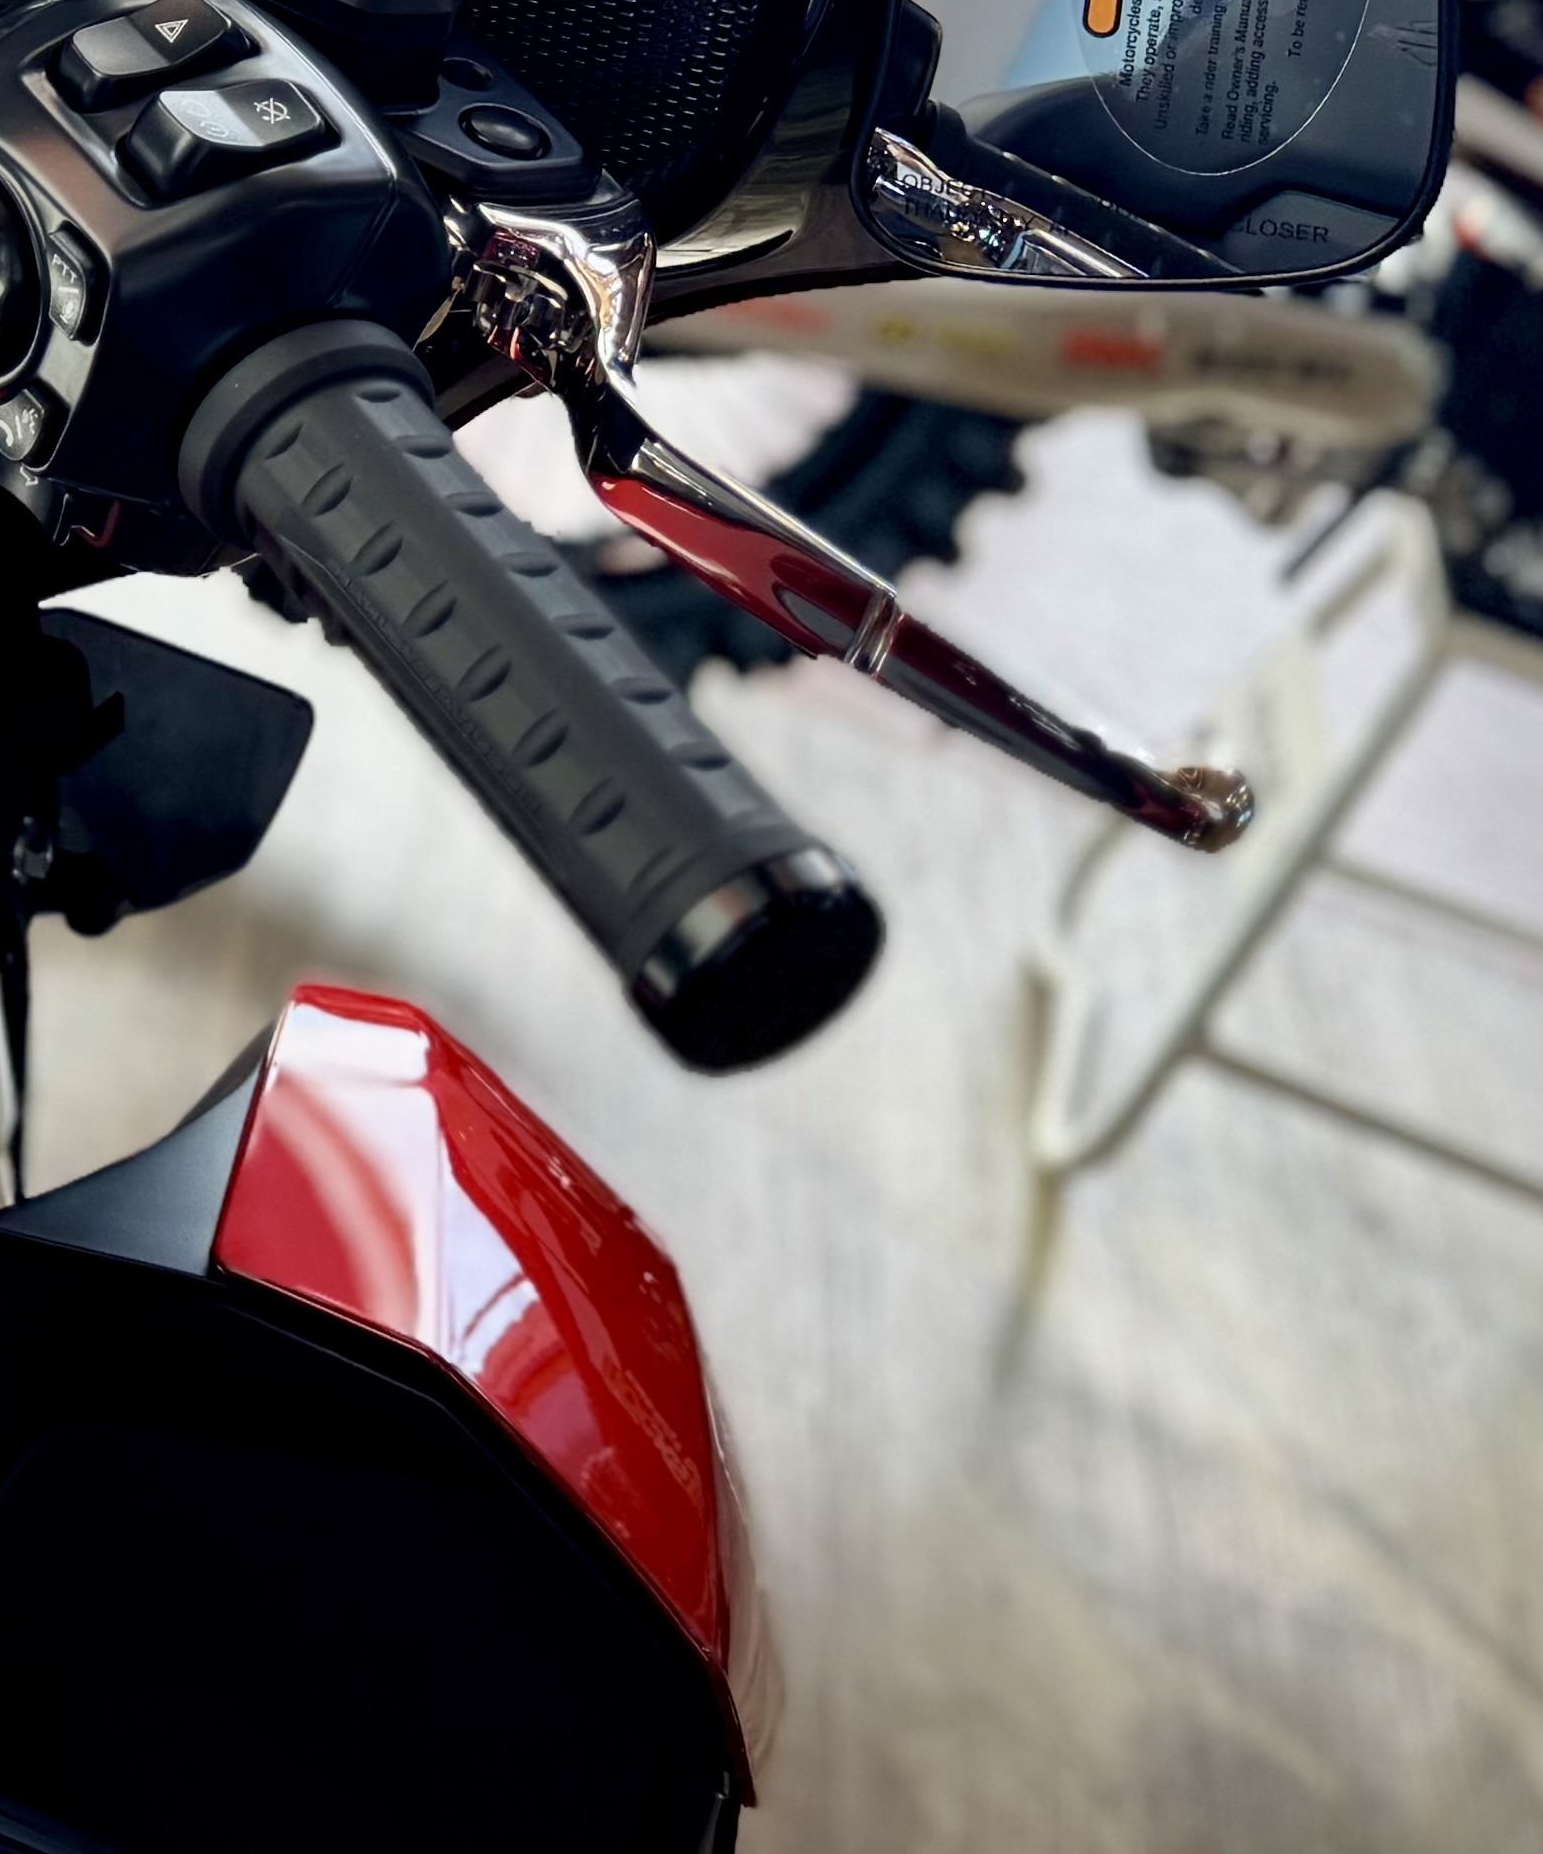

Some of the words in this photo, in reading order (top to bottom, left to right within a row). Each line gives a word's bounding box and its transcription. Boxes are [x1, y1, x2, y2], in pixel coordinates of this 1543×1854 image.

[1142, 5, 1162, 64] operate,
[1292, 21, 1304, 36] be
[1289, 42, 1301, 58] To
[1137, 70, 1154, 102] They
[1155, 64, 1174, 128] Unskilled
[1166, 46, 1176, 58] or
[1196, 107, 1209, 135] Take
[1208, 6, 1225, 54] training
[1247, 52, 1263, 96] adding
[1223, 106, 1236, 139] Read
[1258, 81, 1278, 144] servicing.
[51, 253, 78, 284] PTT
